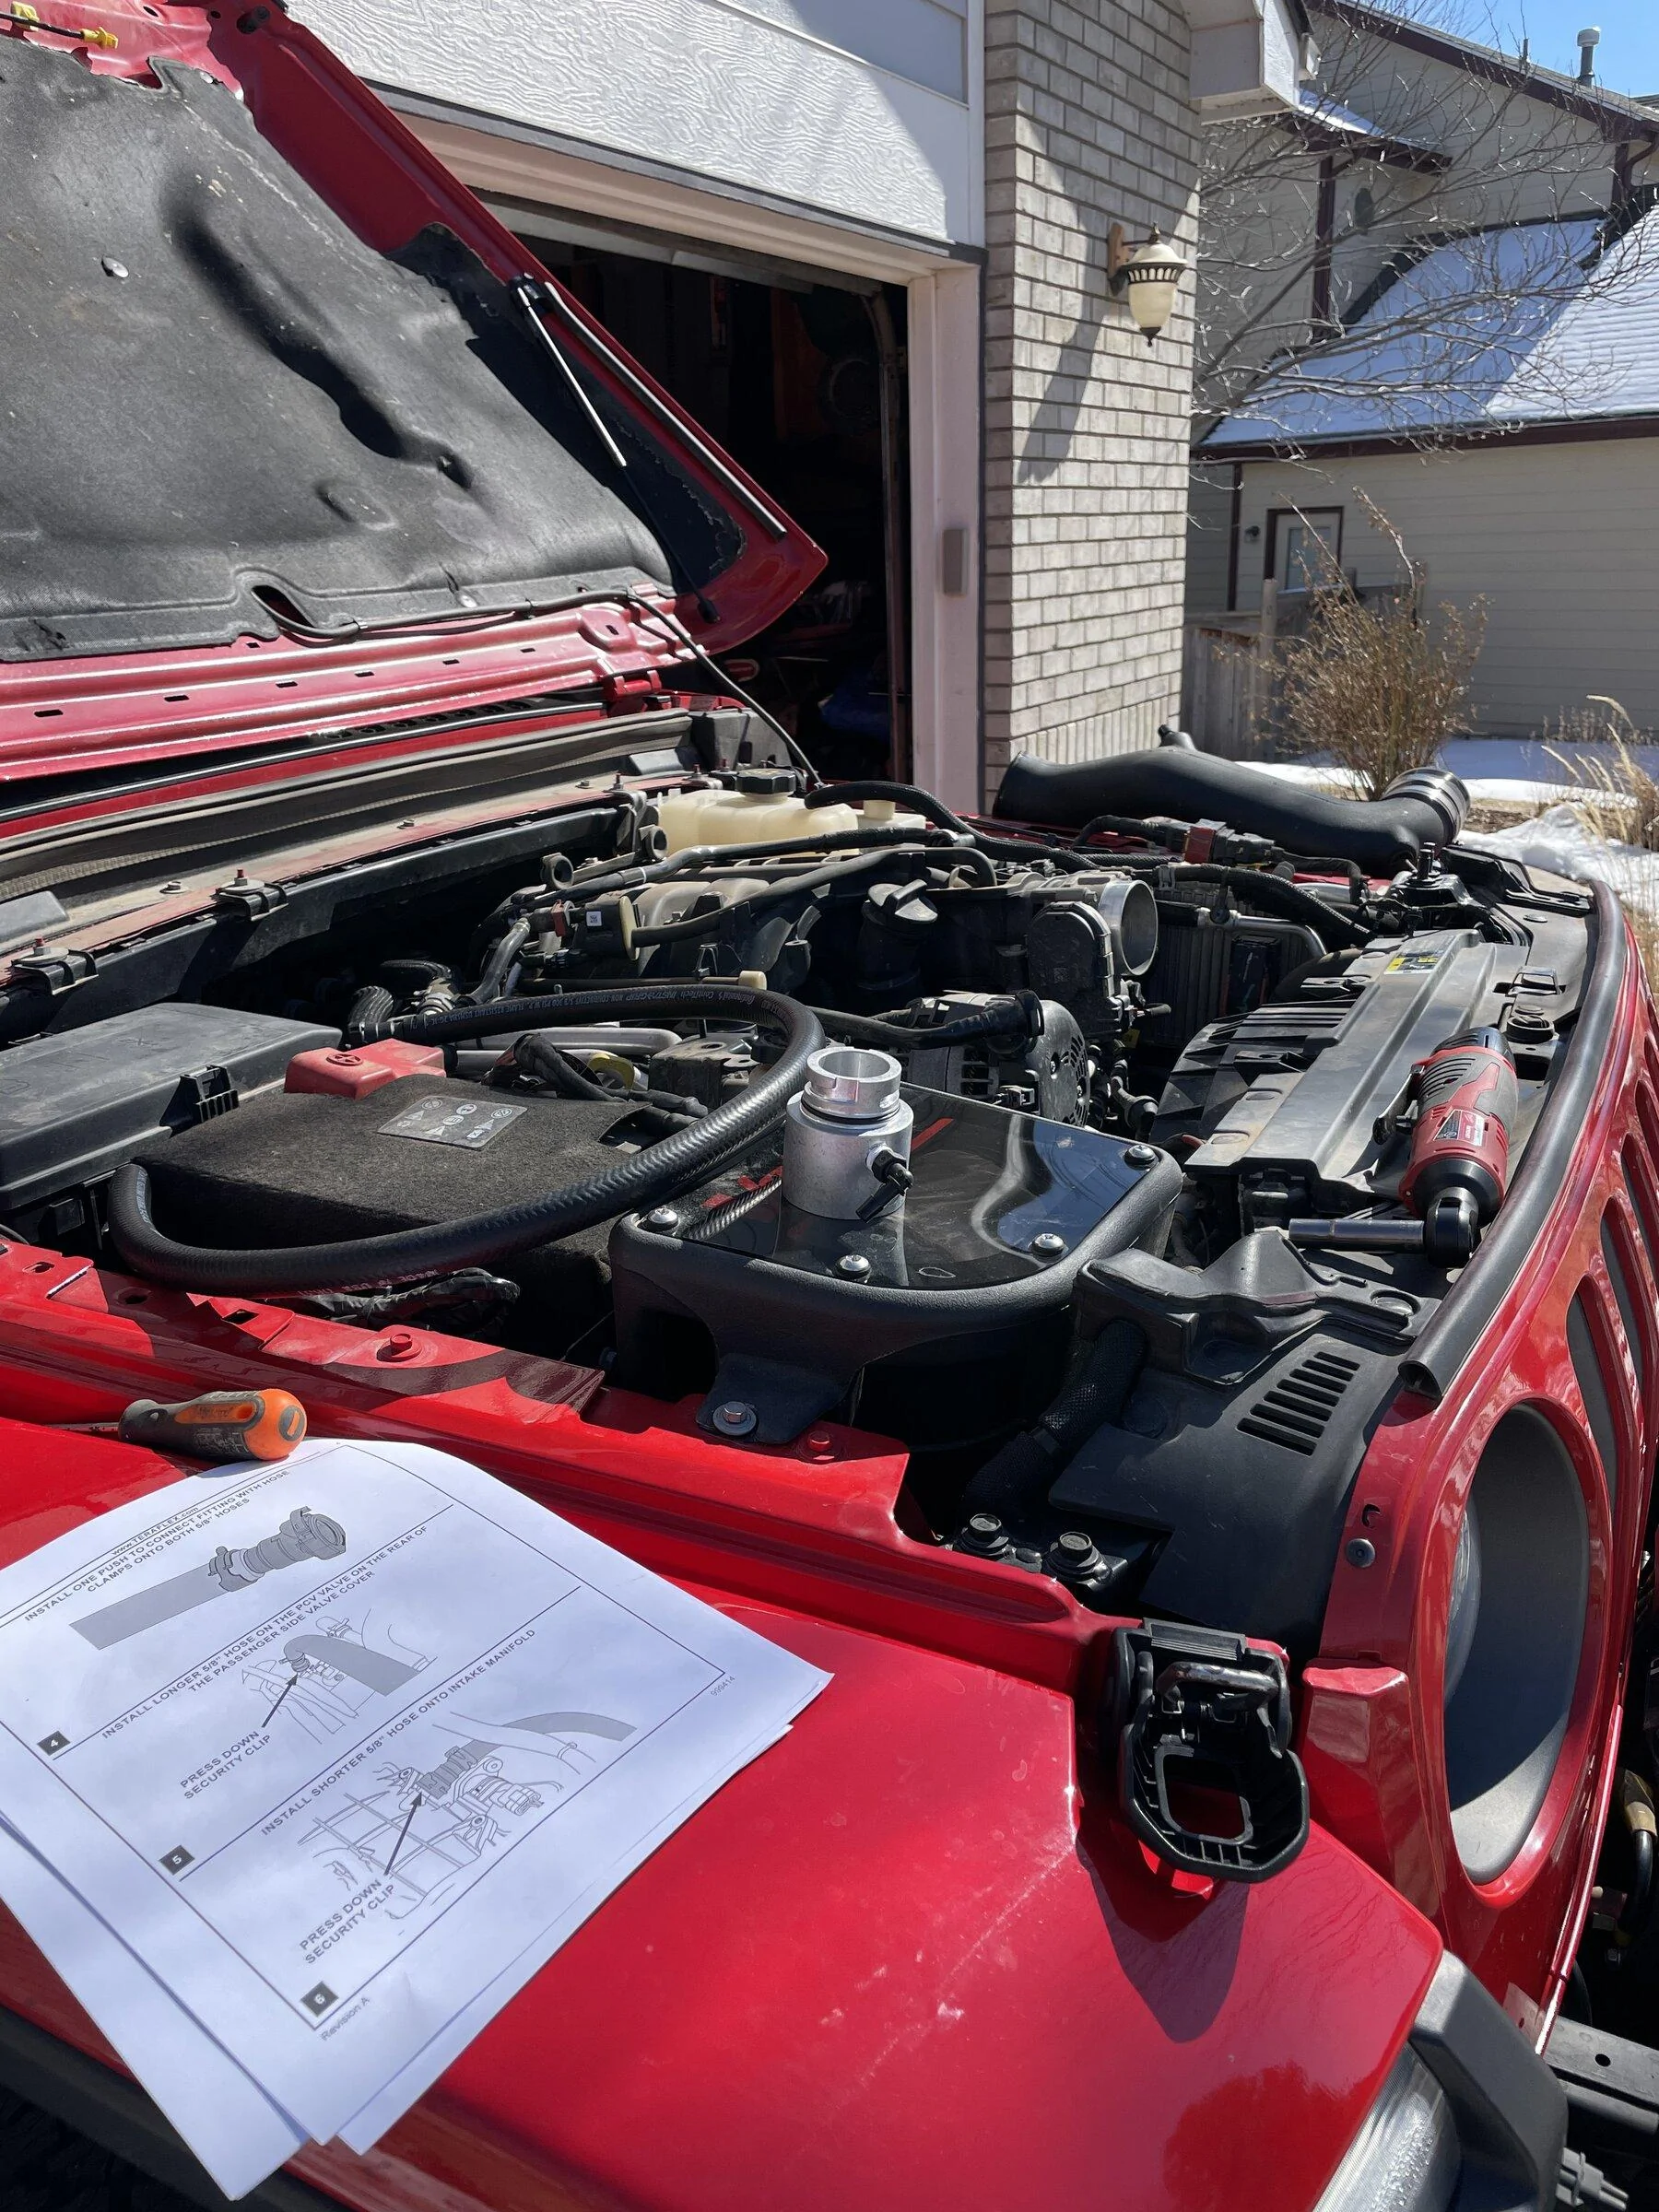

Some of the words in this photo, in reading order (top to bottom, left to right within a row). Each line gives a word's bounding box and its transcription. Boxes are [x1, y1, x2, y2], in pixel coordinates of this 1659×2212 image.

[25, 1590, 74, 1621] INSTALL
[73, 1575, 98, 1592] ONE
[98, 1556, 130, 1576] PUSH
[128, 1546, 146, 1559] TO
[144, 1516, 197, 1549] CONNECT
[195, 1497, 237, 1519] FITTING
[232, 1483, 264, 1500] WITH
[263, 1470, 292, 1486] HOSE
[86, 1562, 134, 1593] CLAMPS
[134, 1544, 168, 1566] ONTO
[165, 1527, 195, 1547] BOTH
[215, 1498, 251, 1518] HOSES
[101, 1701, 151, 1738] INSTALL
[152, 1669, 203, 1705] LONGER
[223, 1635, 256, 1659] HOSE
[253, 1622, 275, 1638] ON
[272, 1606, 298, 1626] THE
[295, 1592, 322, 1609] PCV
[318, 1571, 354, 1596] VALVE
[351, 1563, 371, 1578] ON
[366, 1548, 388, 1566] THE
[385, 1535, 417, 1553] REAR
[414, 1525, 430, 1539] OF
[188, 1675, 214, 1693] THE
[210, 1630, 281, 1680] PASSENGER
[279, 1612, 306, 1633] SIDE
[305, 1589, 341, 1615] VALVE
[339, 1571, 376, 1594] COVER
[179, 1757, 223, 1788] PRESS
[221, 1731, 259, 1759] DOWN
[183, 1754, 244, 1799] SECURITY
[244, 1734, 271, 1756] CLIP
[261, 1790, 311, 1836] INSTALL
[311, 1749, 368, 1797] SHORTER
[387, 1712, 419, 1738] HOSE
[418, 1690, 450, 1714] ONTO
[447, 1664, 488, 1693] INTAKE
[485, 1629, 536, 1668] MANIFOLD
[300, 1912, 343, 1951] PRESS
[342, 1878, 382, 1914] DOWN
[304, 1909, 367, 1964] SECURITY
[367, 1884, 395, 1911] CLIP
[321, 2004, 362, 2041] Revision
